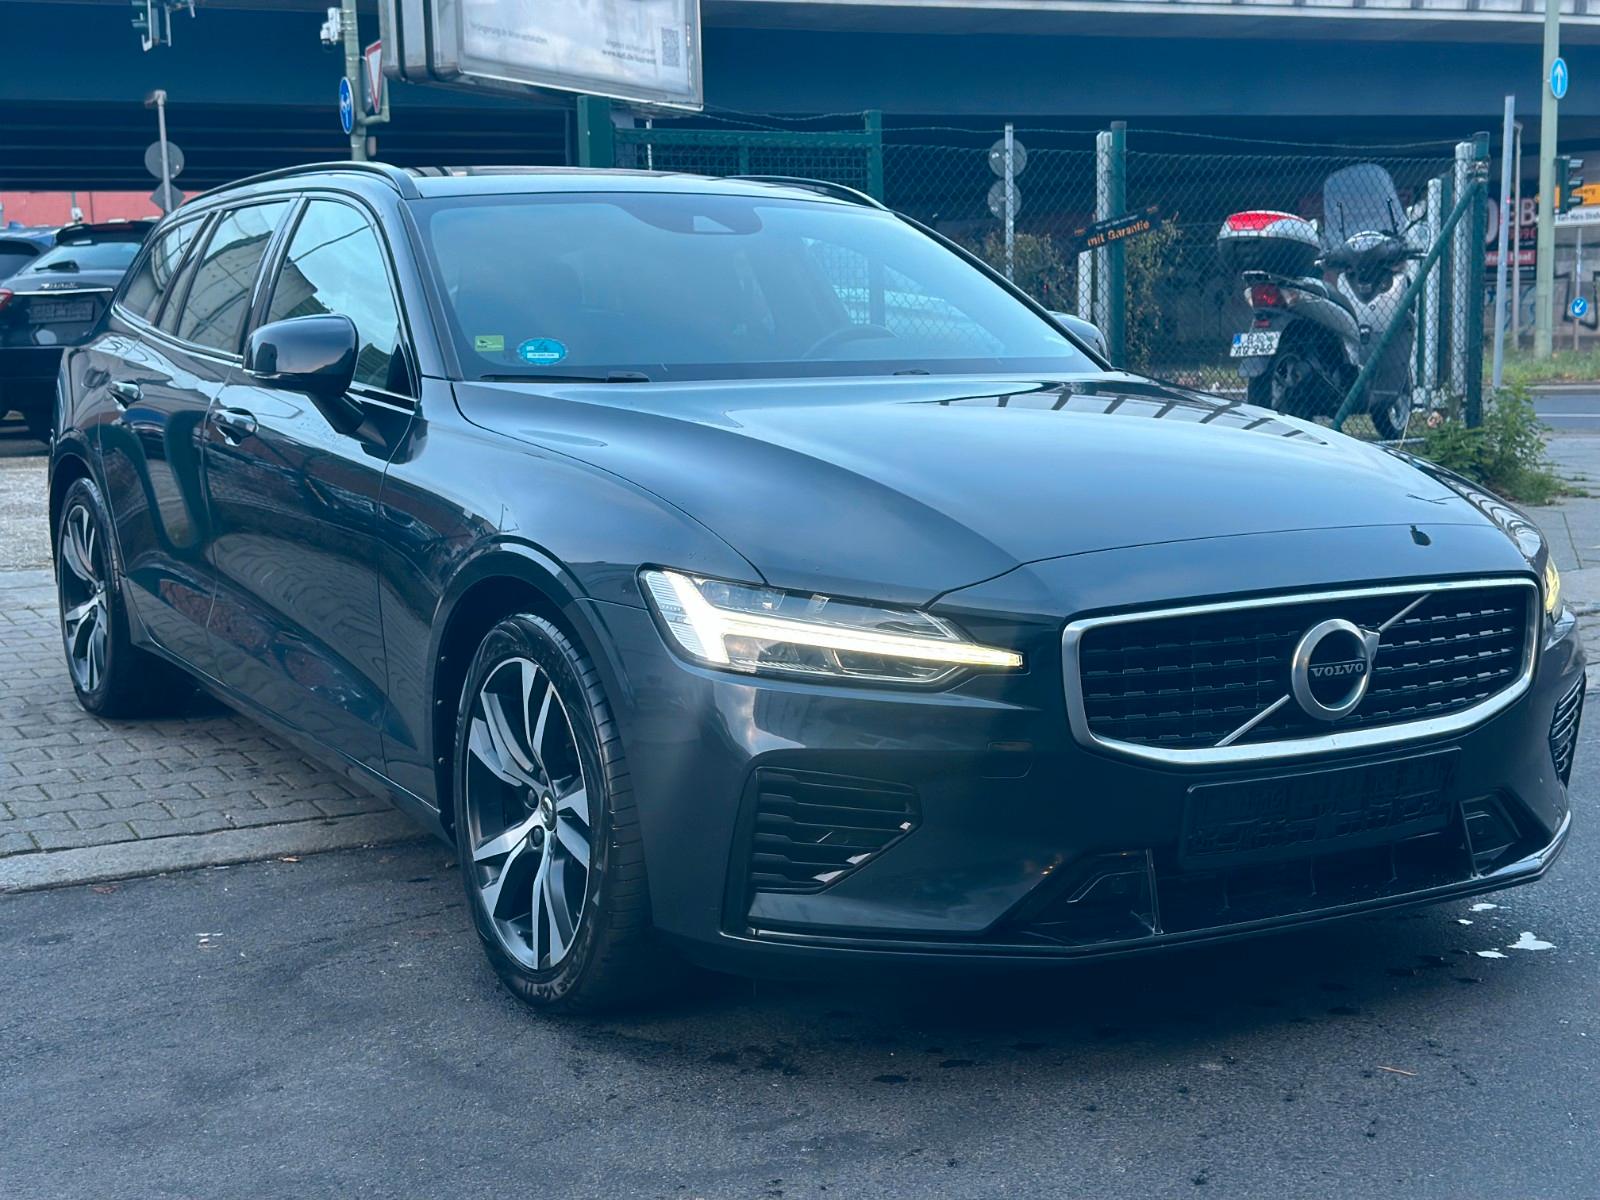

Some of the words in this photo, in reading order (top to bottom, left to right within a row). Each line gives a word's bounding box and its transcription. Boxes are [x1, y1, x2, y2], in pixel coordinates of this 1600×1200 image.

[1087, 233, 1105, 247] mit
[1107, 220, 1150, 240] Garantie
[1310, 662, 1364, 677] VOLVO
